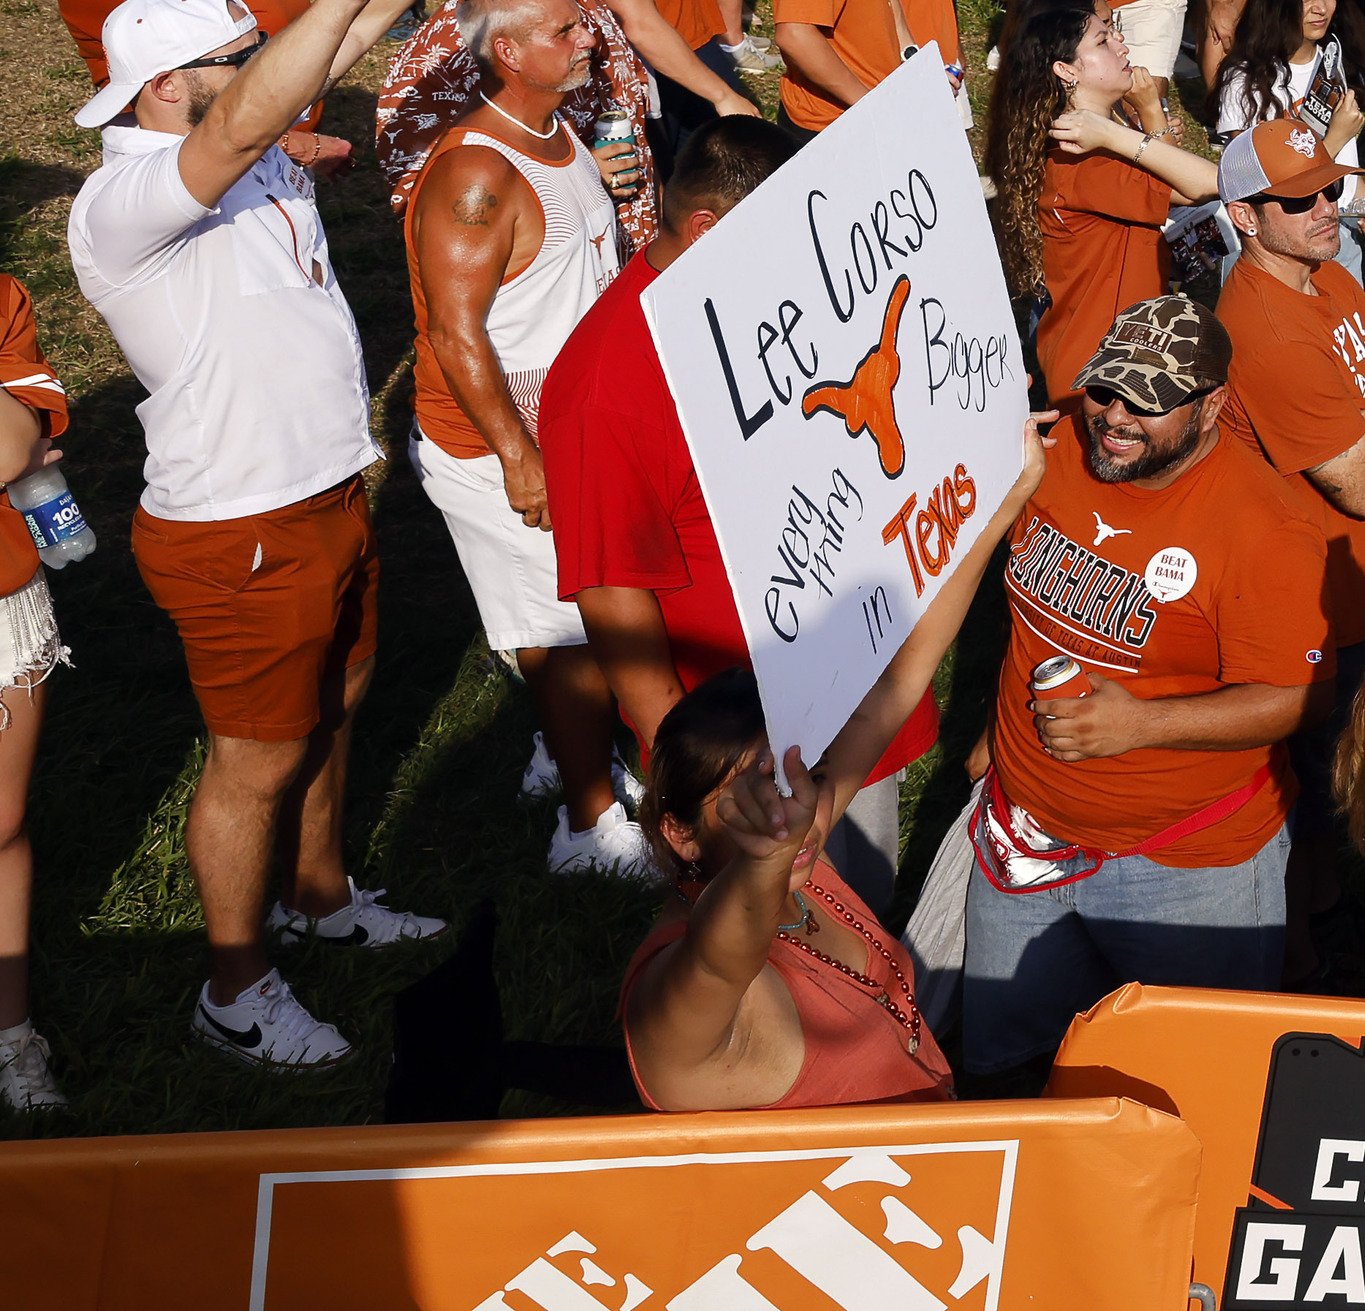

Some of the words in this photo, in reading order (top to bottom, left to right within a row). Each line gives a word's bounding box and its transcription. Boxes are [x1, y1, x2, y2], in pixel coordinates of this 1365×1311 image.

[1123, 322, 1169, 347] YETI
[702, 294, 819, 443] Lee
[879, 462, 977, 600] Texas
[1154, 566, 1184, 582] BAMA
[1160, 553, 1188, 569] BEAT
[858, 580, 893, 655] in
